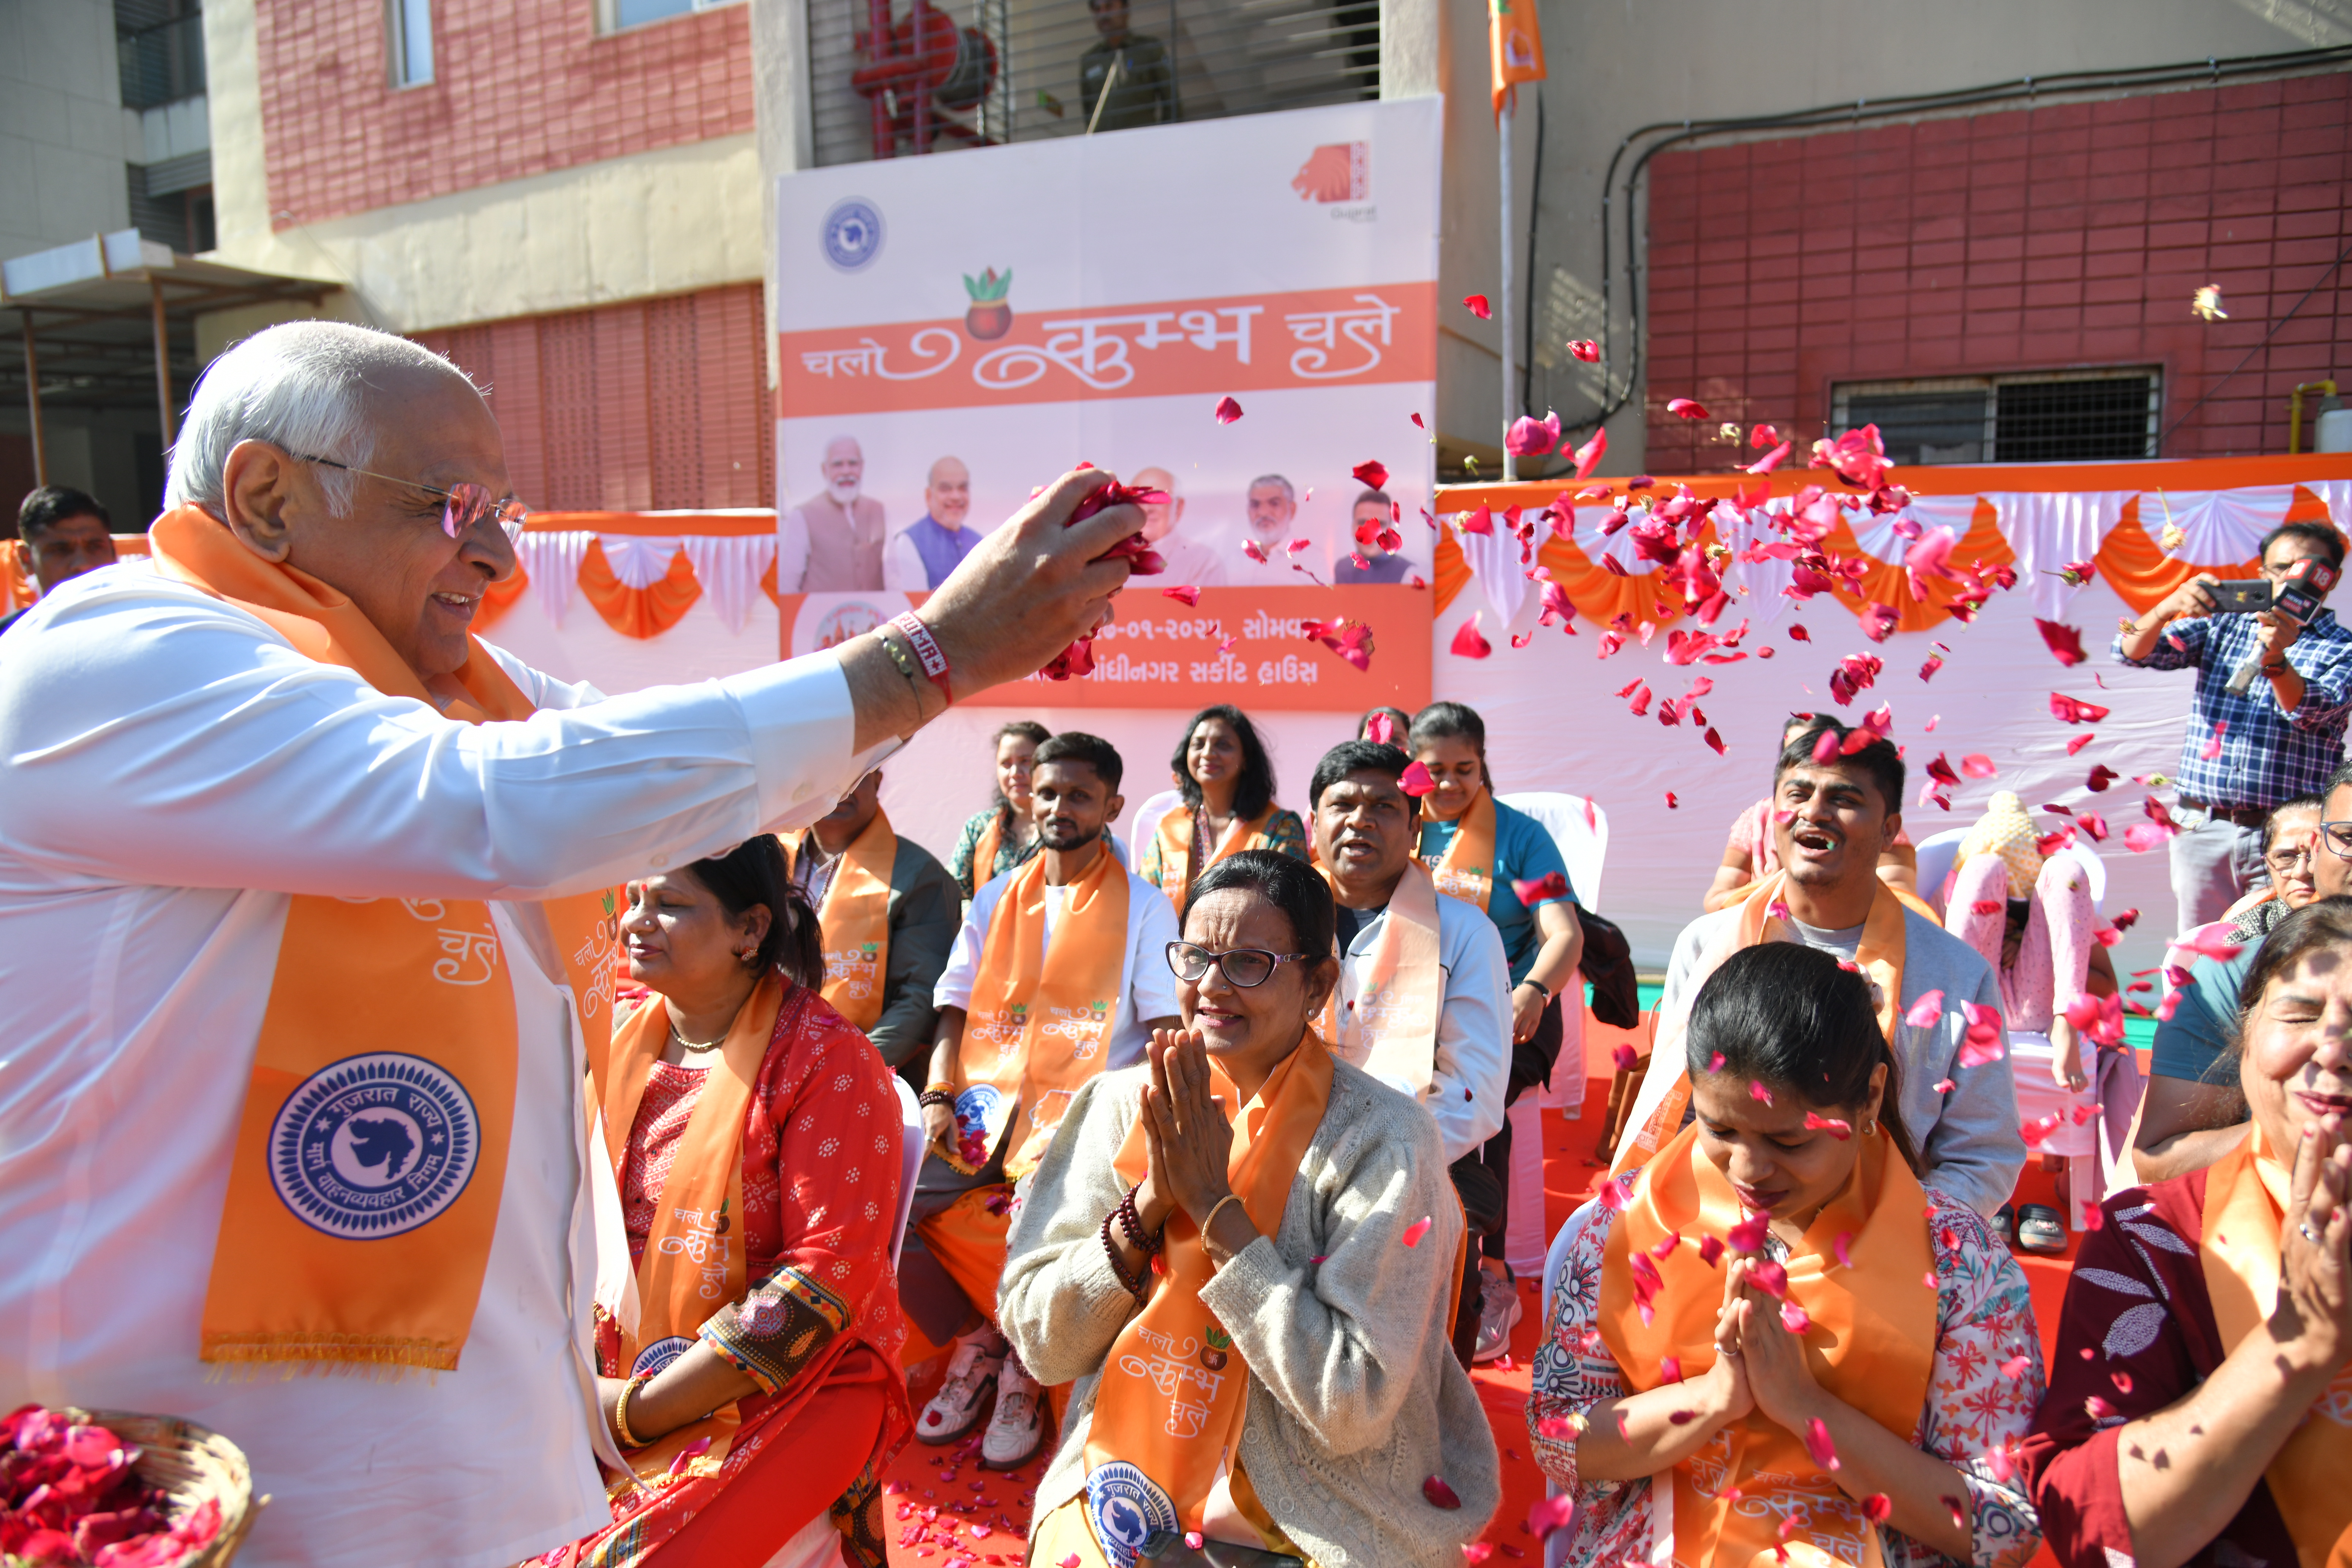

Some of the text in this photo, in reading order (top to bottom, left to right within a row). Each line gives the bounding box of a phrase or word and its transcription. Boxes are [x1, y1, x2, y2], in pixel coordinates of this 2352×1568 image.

[801, 329, 961, 379] चलो
[972, 306, 1264, 390] कुम्भ
[2314, 568, 2330, 586] 18
[1094, 619, 1230, 641] ૭-૦૧-૨૦૨૫,
[1257, 654, 1318, 684] હાઉસ
[574, 920, 607, 966] चलो
[327, 1087, 443, 1128] गुजरात राज्य
[306, 1142, 331, 1171] मार्ग
[406, 1154, 443, 1190] निगम
[1138, 1325, 1198, 1359] चलो
[1119, 1354, 1225, 1403] कुम्भ
[1165, 1399, 1211, 1438] चले
[1105, 1484, 1159, 1525] गुजरात राज्य
